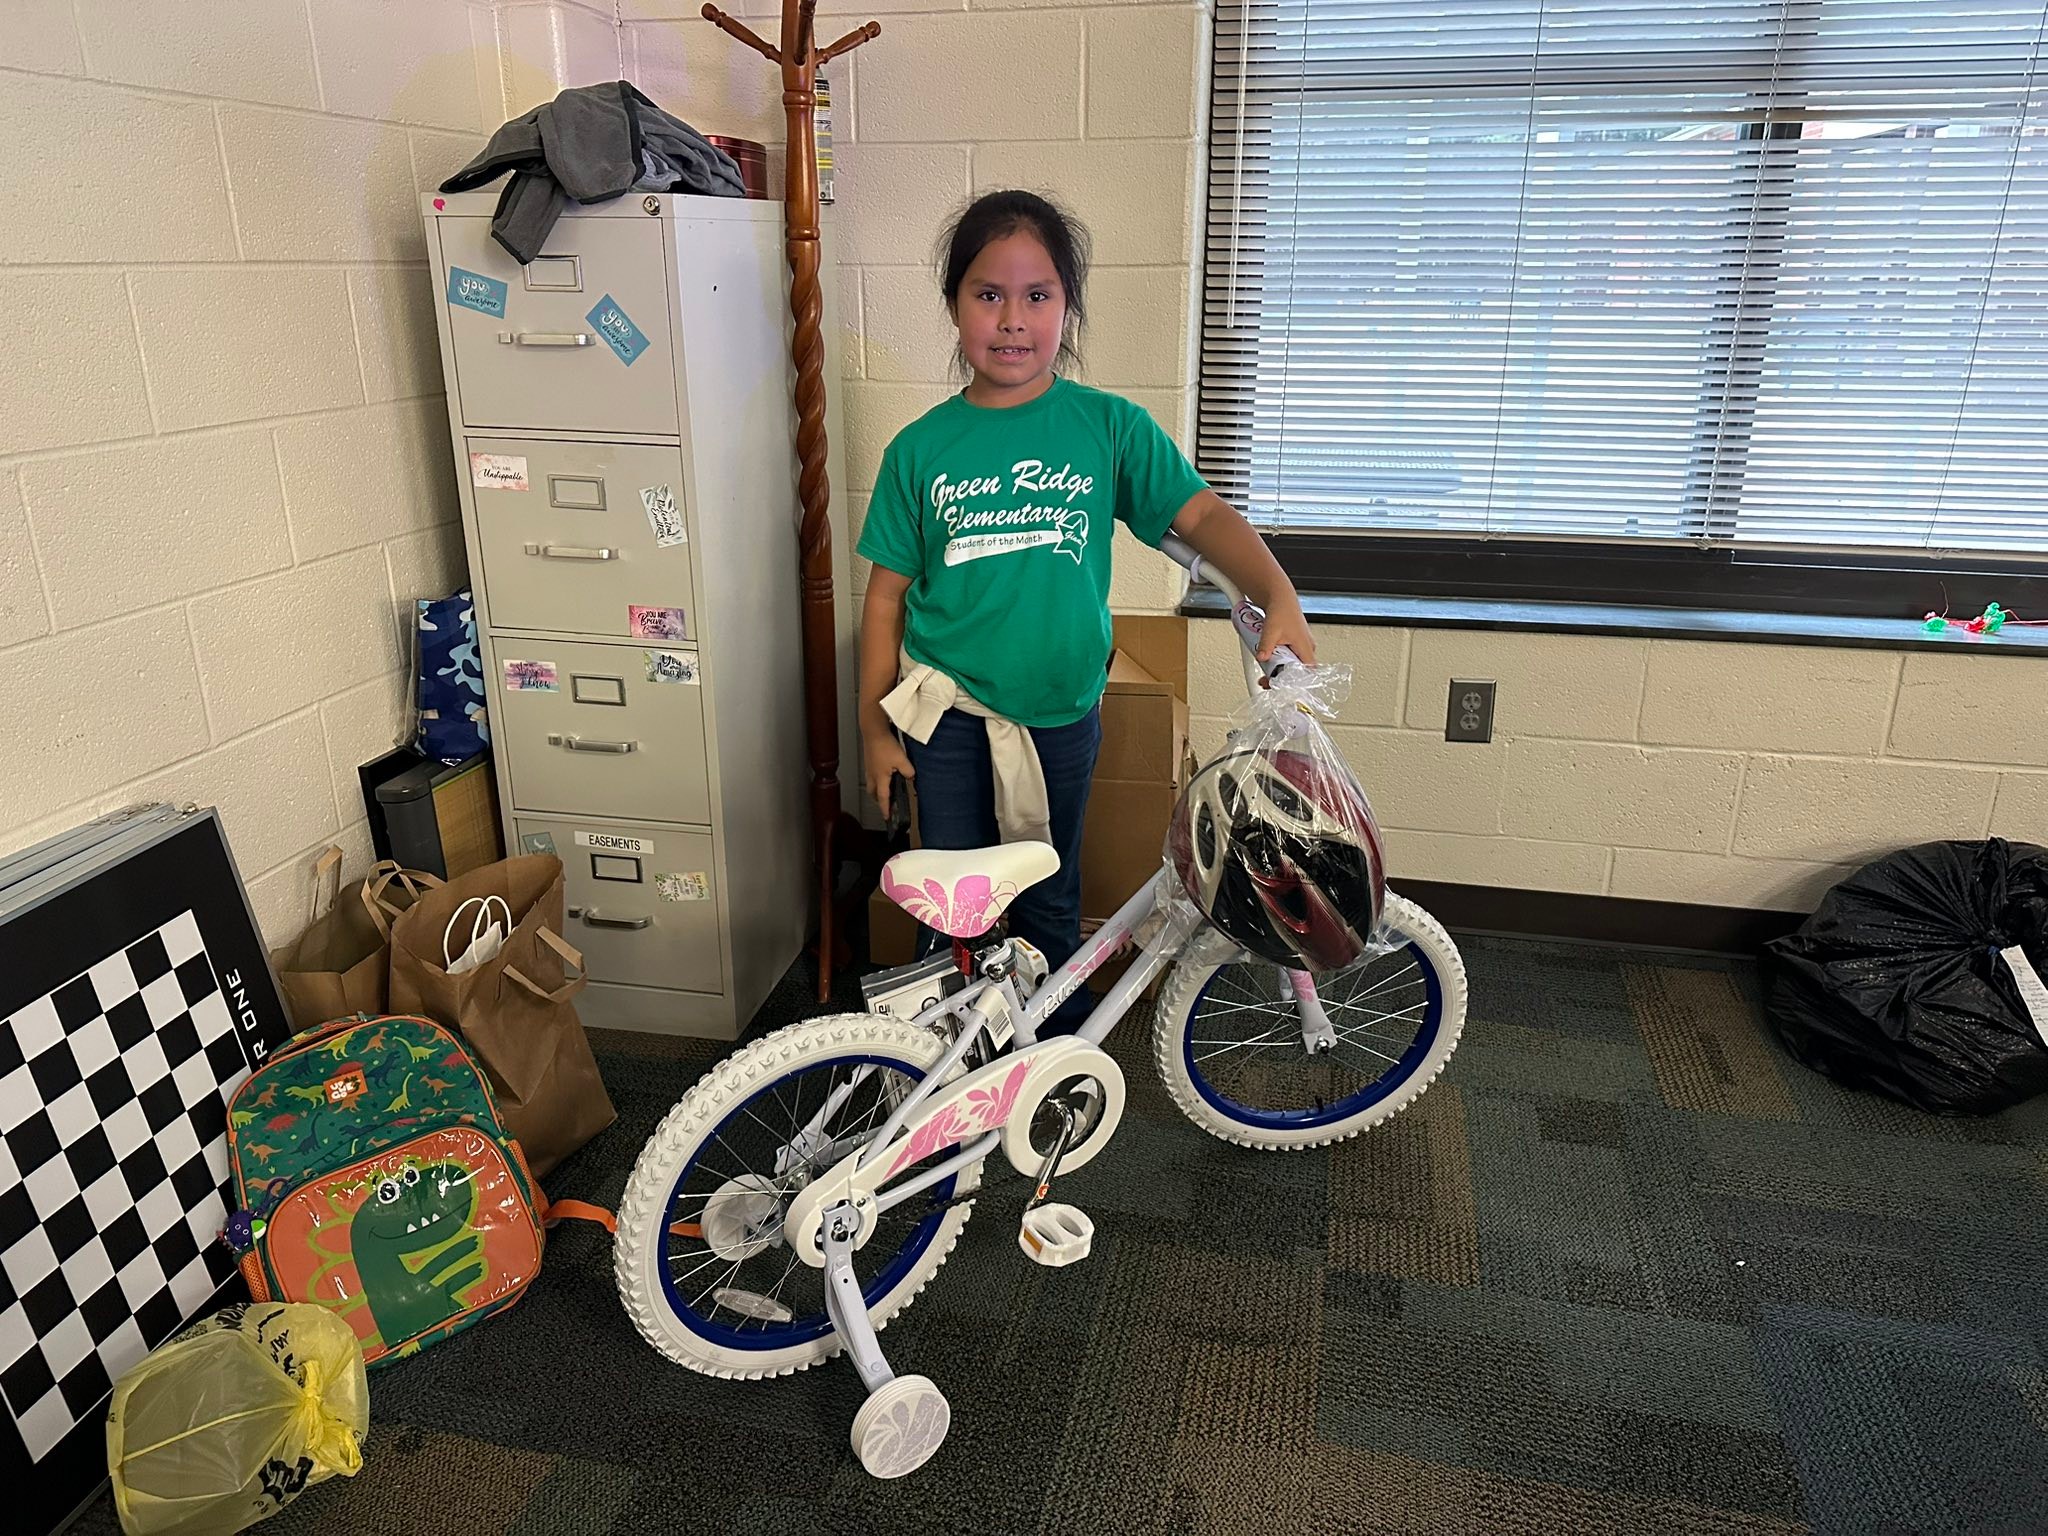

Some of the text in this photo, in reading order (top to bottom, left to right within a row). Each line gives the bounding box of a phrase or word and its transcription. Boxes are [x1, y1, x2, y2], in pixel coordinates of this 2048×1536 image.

[464, 295, 499, 309] awesome
[602, 325, 632, 355] awesome
[931, 459, 1094, 521] Green Ridge
[943, 502, 1069, 537] Elementary
[950, 533, 1043, 551] Student of the Month
[638, 612, 664, 626] Brave
[660, 654, 682, 668] You
[655, 662, 692, 681] Amazing
[588, 834, 641, 851] EASEMENTS
[225, 968, 257, 1031] ONE
[331, 1090, 348, 1099] GO
